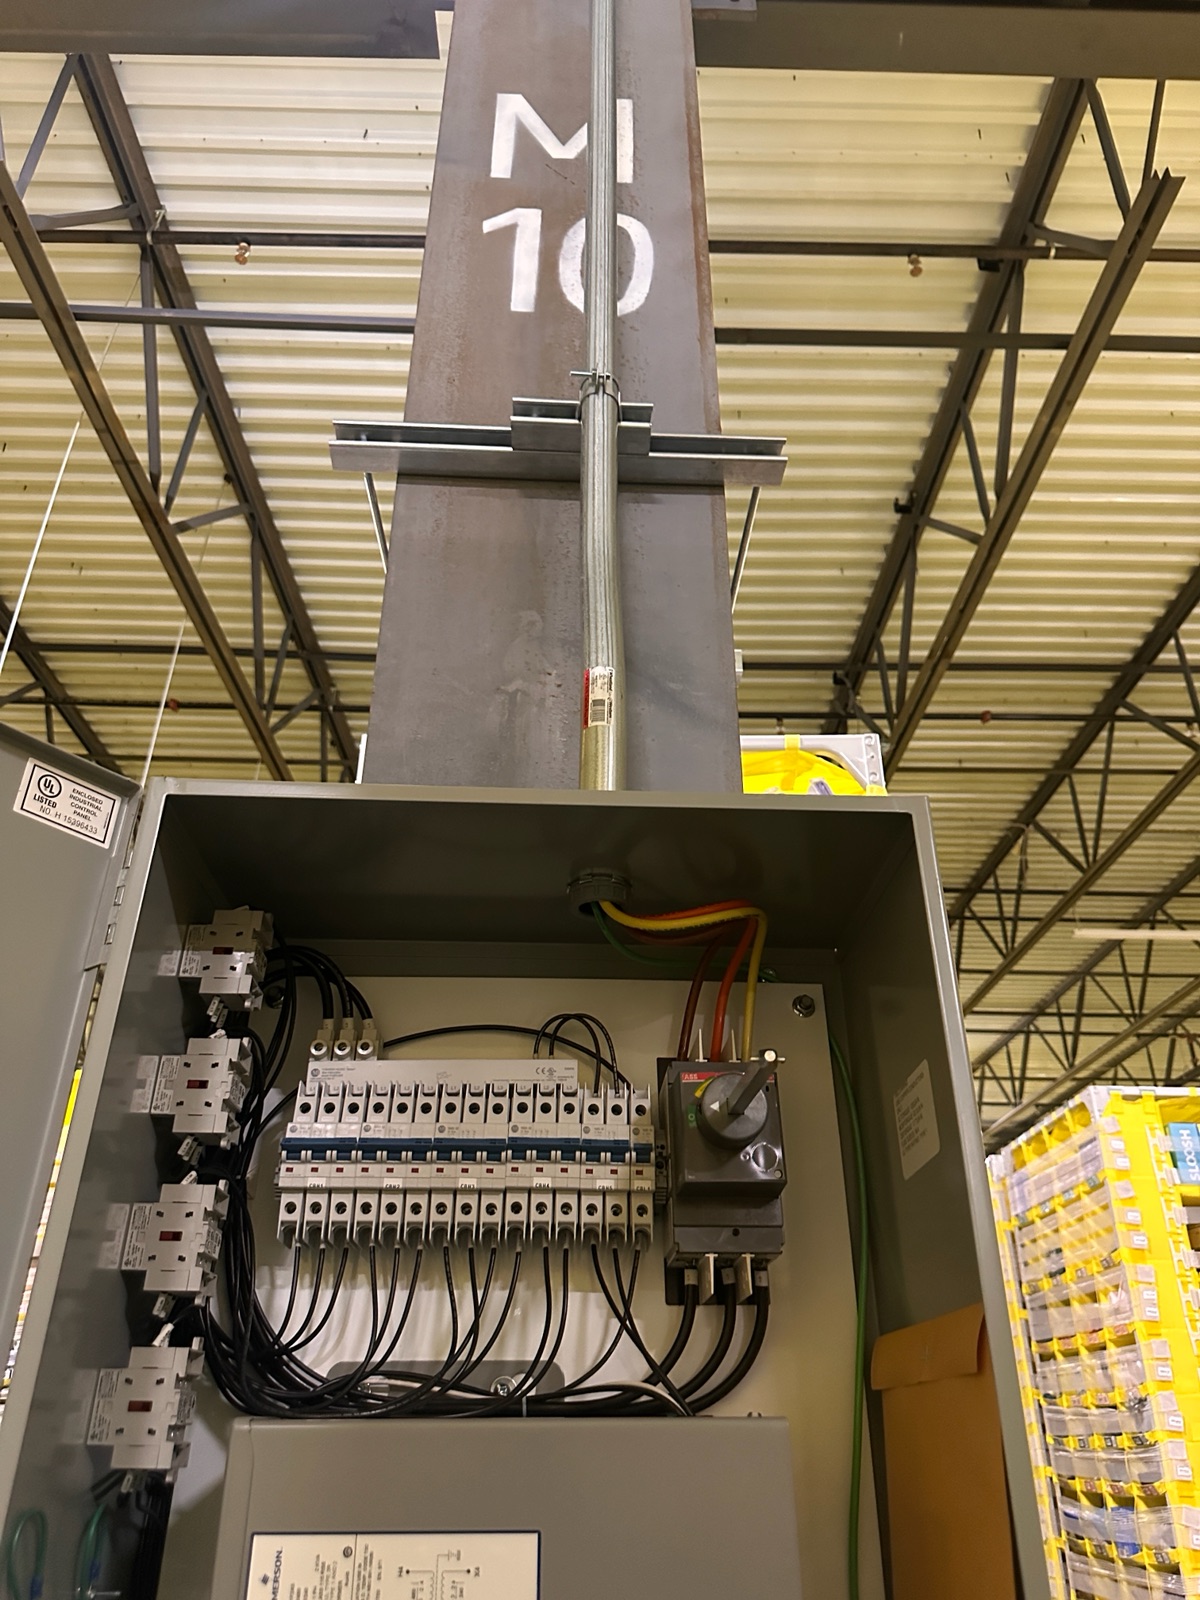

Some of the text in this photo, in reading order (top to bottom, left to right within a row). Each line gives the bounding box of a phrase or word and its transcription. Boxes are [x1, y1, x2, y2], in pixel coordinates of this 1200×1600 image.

[490, 93, 634, 184] M
[482, 208, 654, 317] 10
[43, 778, 55, 794] UL
[33, 793, 57, 808] LISTED
[69, 794, 102, 812] INDUSTRIAL
[72, 788, 103, 805] ENCLOSED
[54, 811, 62, 819] H
[70, 802, 98, 817] CONTROL
[73, 810, 91, 821] PANEL
[1179, 1129, 1200, 1181] SLOOSH
